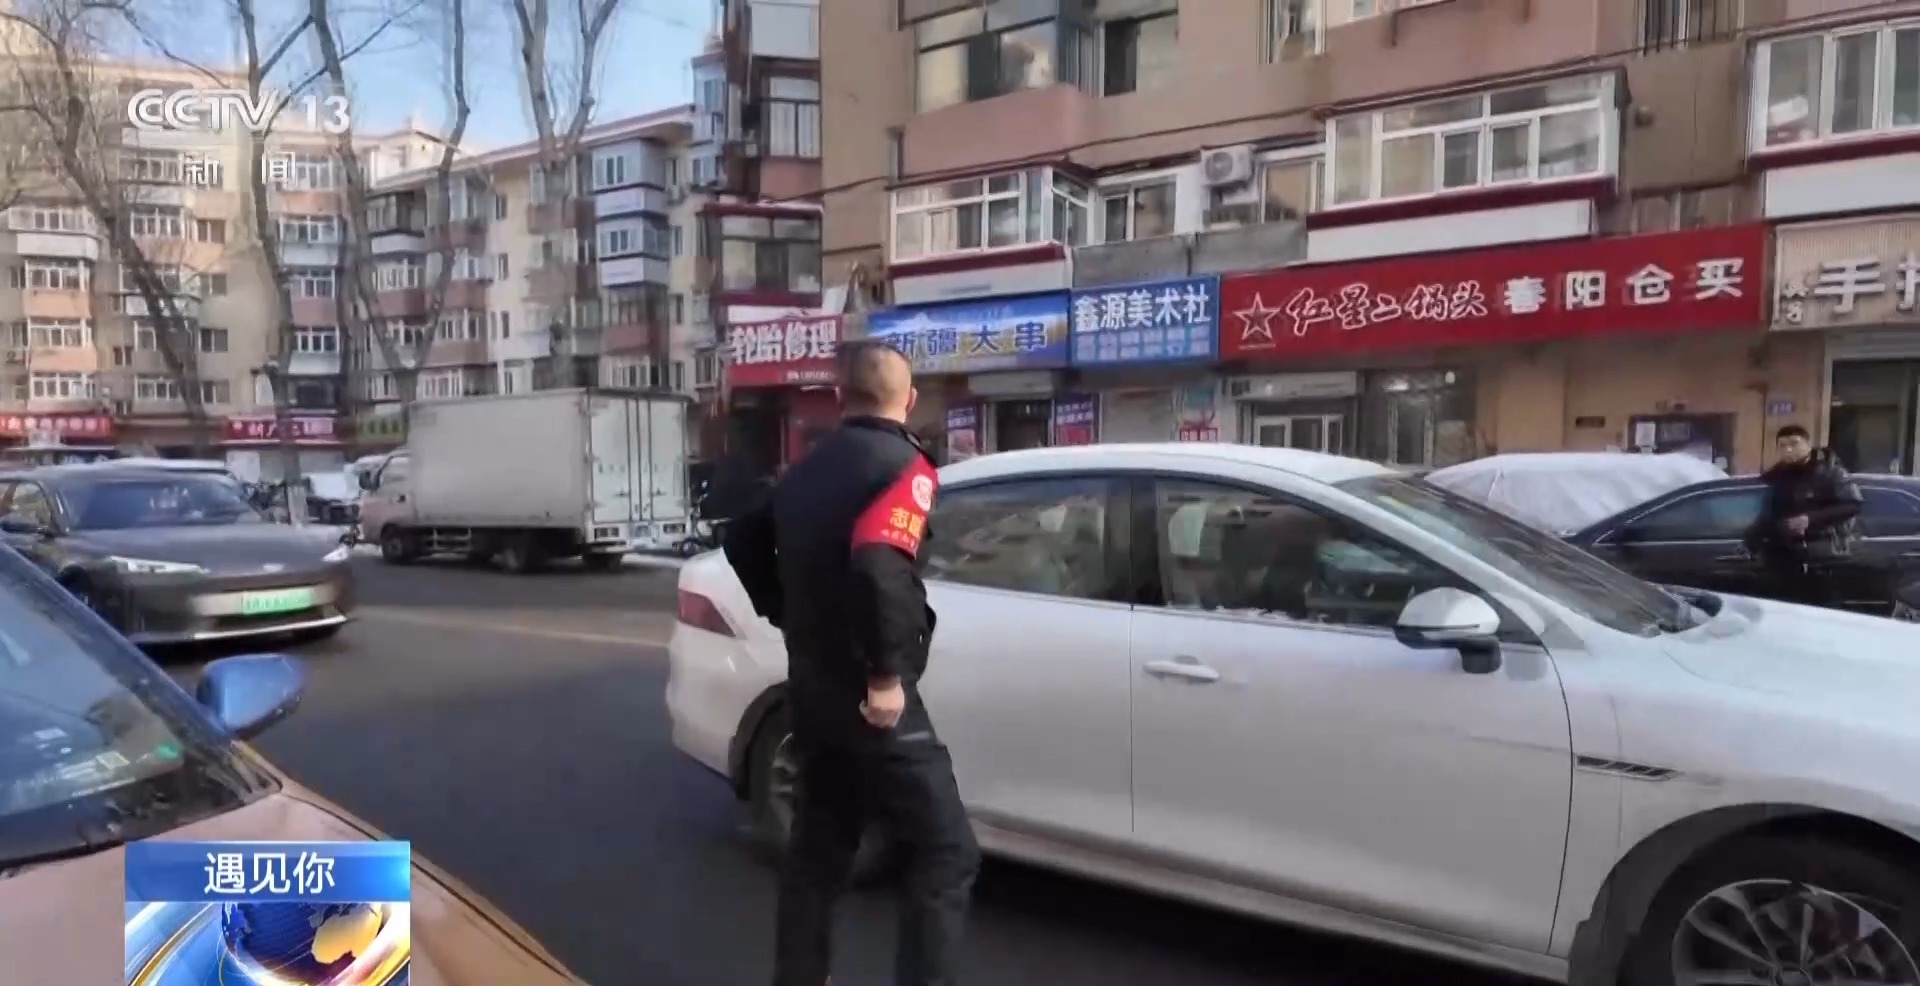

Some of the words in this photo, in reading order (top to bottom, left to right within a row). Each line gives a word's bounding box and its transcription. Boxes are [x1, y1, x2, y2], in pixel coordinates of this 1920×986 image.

[1074, 282, 1212, 332] 鑫源美术社
[1286, 279, 1489, 336] 红星二锅头
[1503, 257, 1746, 315] 春阳仓买
[730, 319, 838, 366] 轮胎修理
